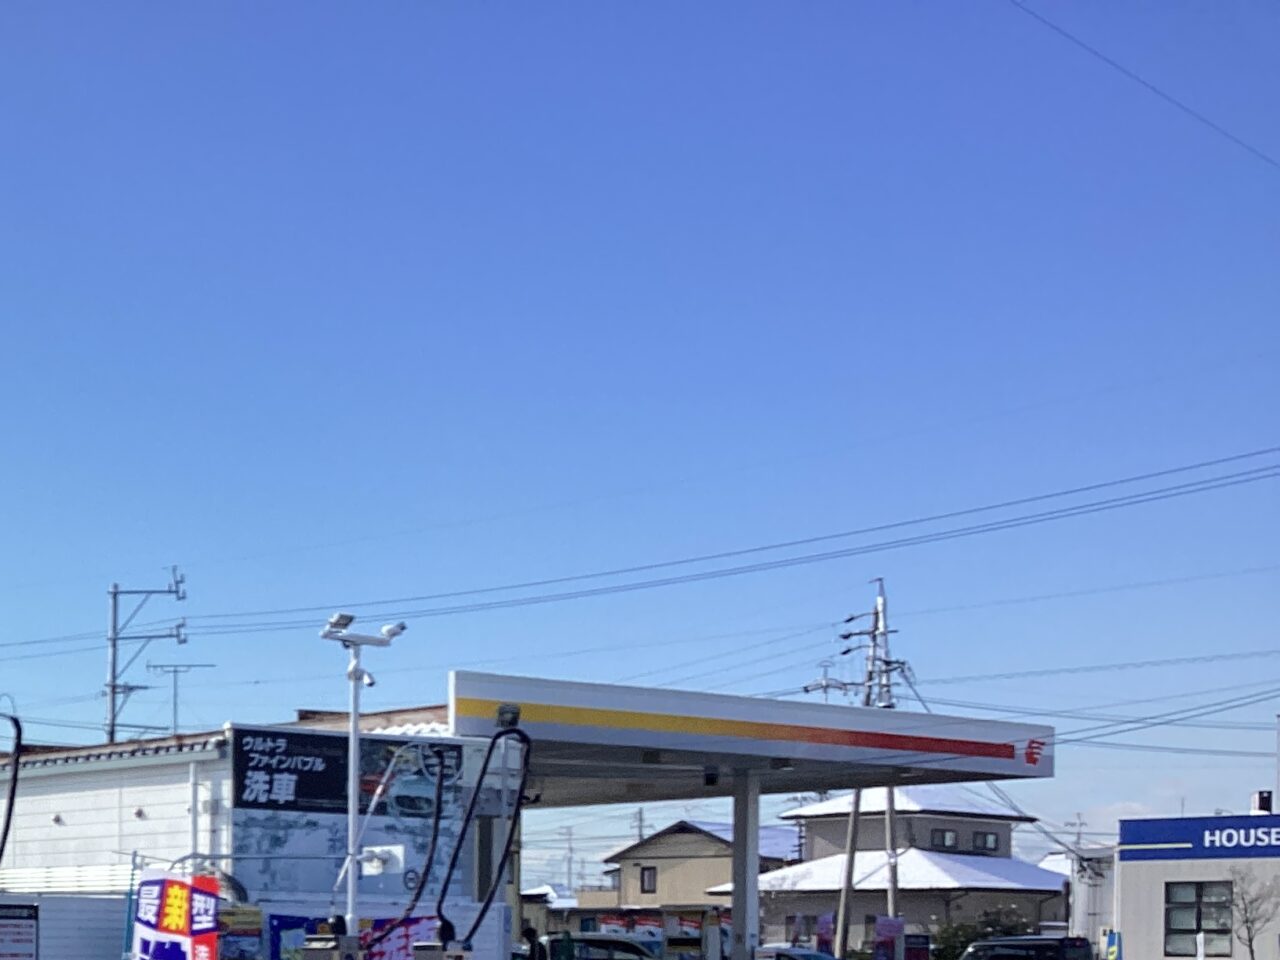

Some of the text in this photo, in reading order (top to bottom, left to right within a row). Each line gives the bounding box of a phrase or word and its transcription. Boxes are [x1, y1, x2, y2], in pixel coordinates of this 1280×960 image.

[241, 737, 288, 753] ウルトラ
[247, 753, 326, 772] ファインバブル
[242, 770, 298, 804] 洗車
[1203, 828, 1280, 848] HOUSE
[137, 885, 217, 931] 最新型
